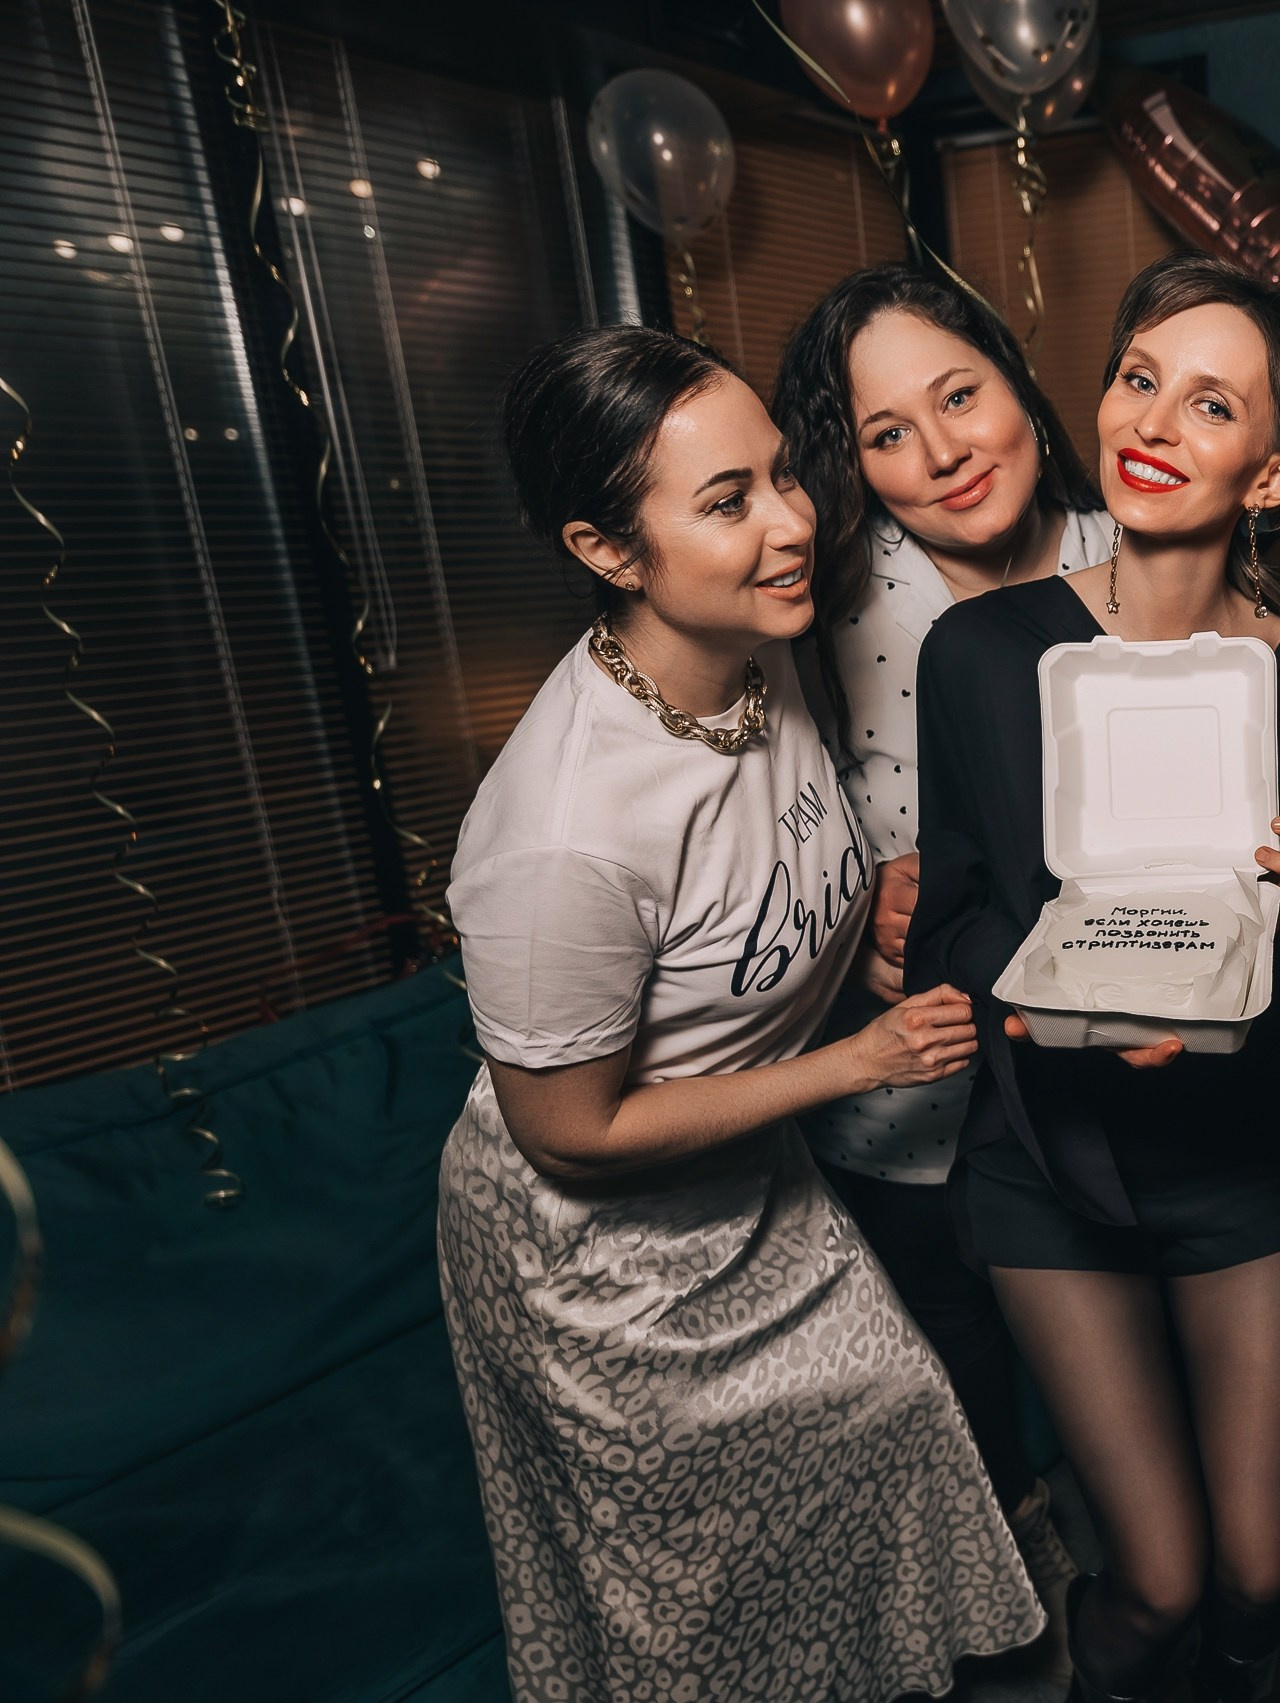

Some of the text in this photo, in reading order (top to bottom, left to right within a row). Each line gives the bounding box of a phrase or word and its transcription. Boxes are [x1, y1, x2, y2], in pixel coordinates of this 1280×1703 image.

[778, 781, 827, 850] TEAM
[731, 781, 873, 997] Brid
[1084, 918, 1209, 928] если хочешь
[1095, 929, 1200, 939] позвонить
